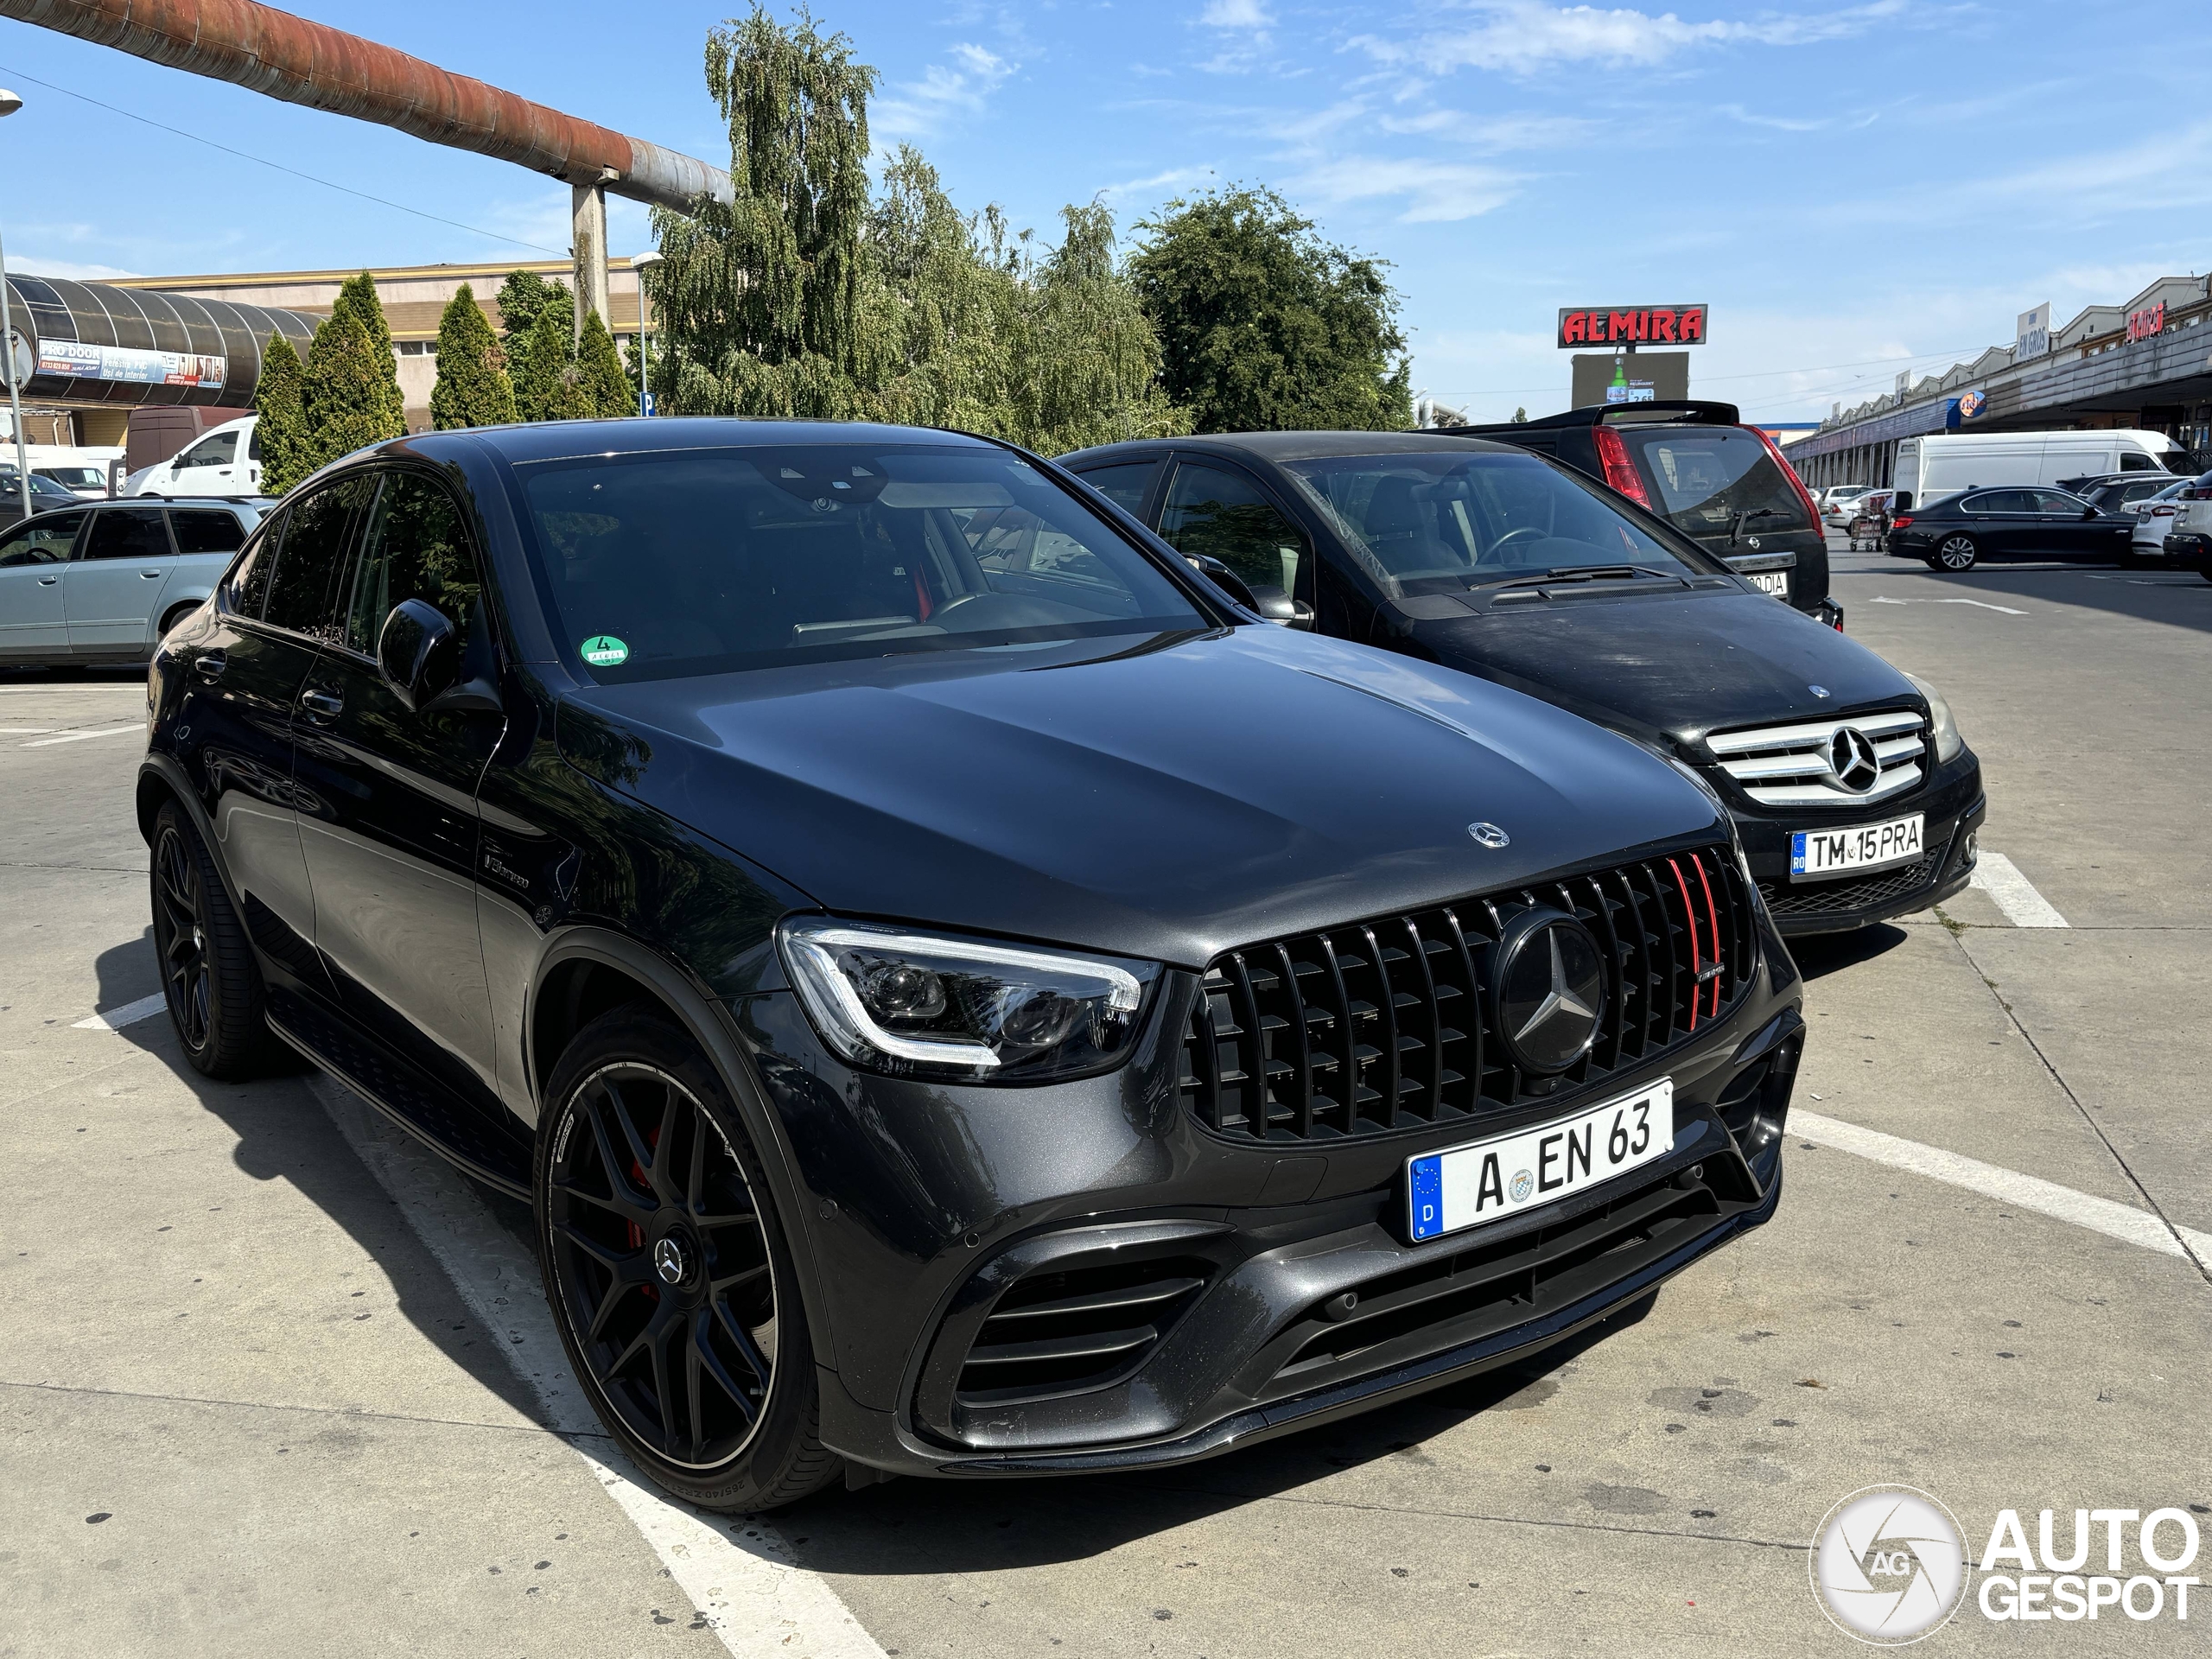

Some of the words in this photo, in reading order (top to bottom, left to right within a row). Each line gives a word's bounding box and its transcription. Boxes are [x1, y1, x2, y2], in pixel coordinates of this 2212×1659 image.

[1563, 308, 1702, 345] ALMIRA
[41, 344, 66, 356] PRO
[68, 346, 100, 359] DOOR
[2018, 334, 2028, 358] EN
[2028, 326, 2046, 354] GROS
[645, 394, 653, 416] P
[1764, 575, 1783, 594] DIA
[596, 637, 611, 651] 4
[1812, 834, 1846, 868] TM
[1793, 856, 1805, 870] RO
[1476, 1152, 1504, 1212] A
[1539, 1122, 1592, 1193] EN
[1608, 1098, 1650, 1165] 63
[1422, 1205, 1433, 1222] D
